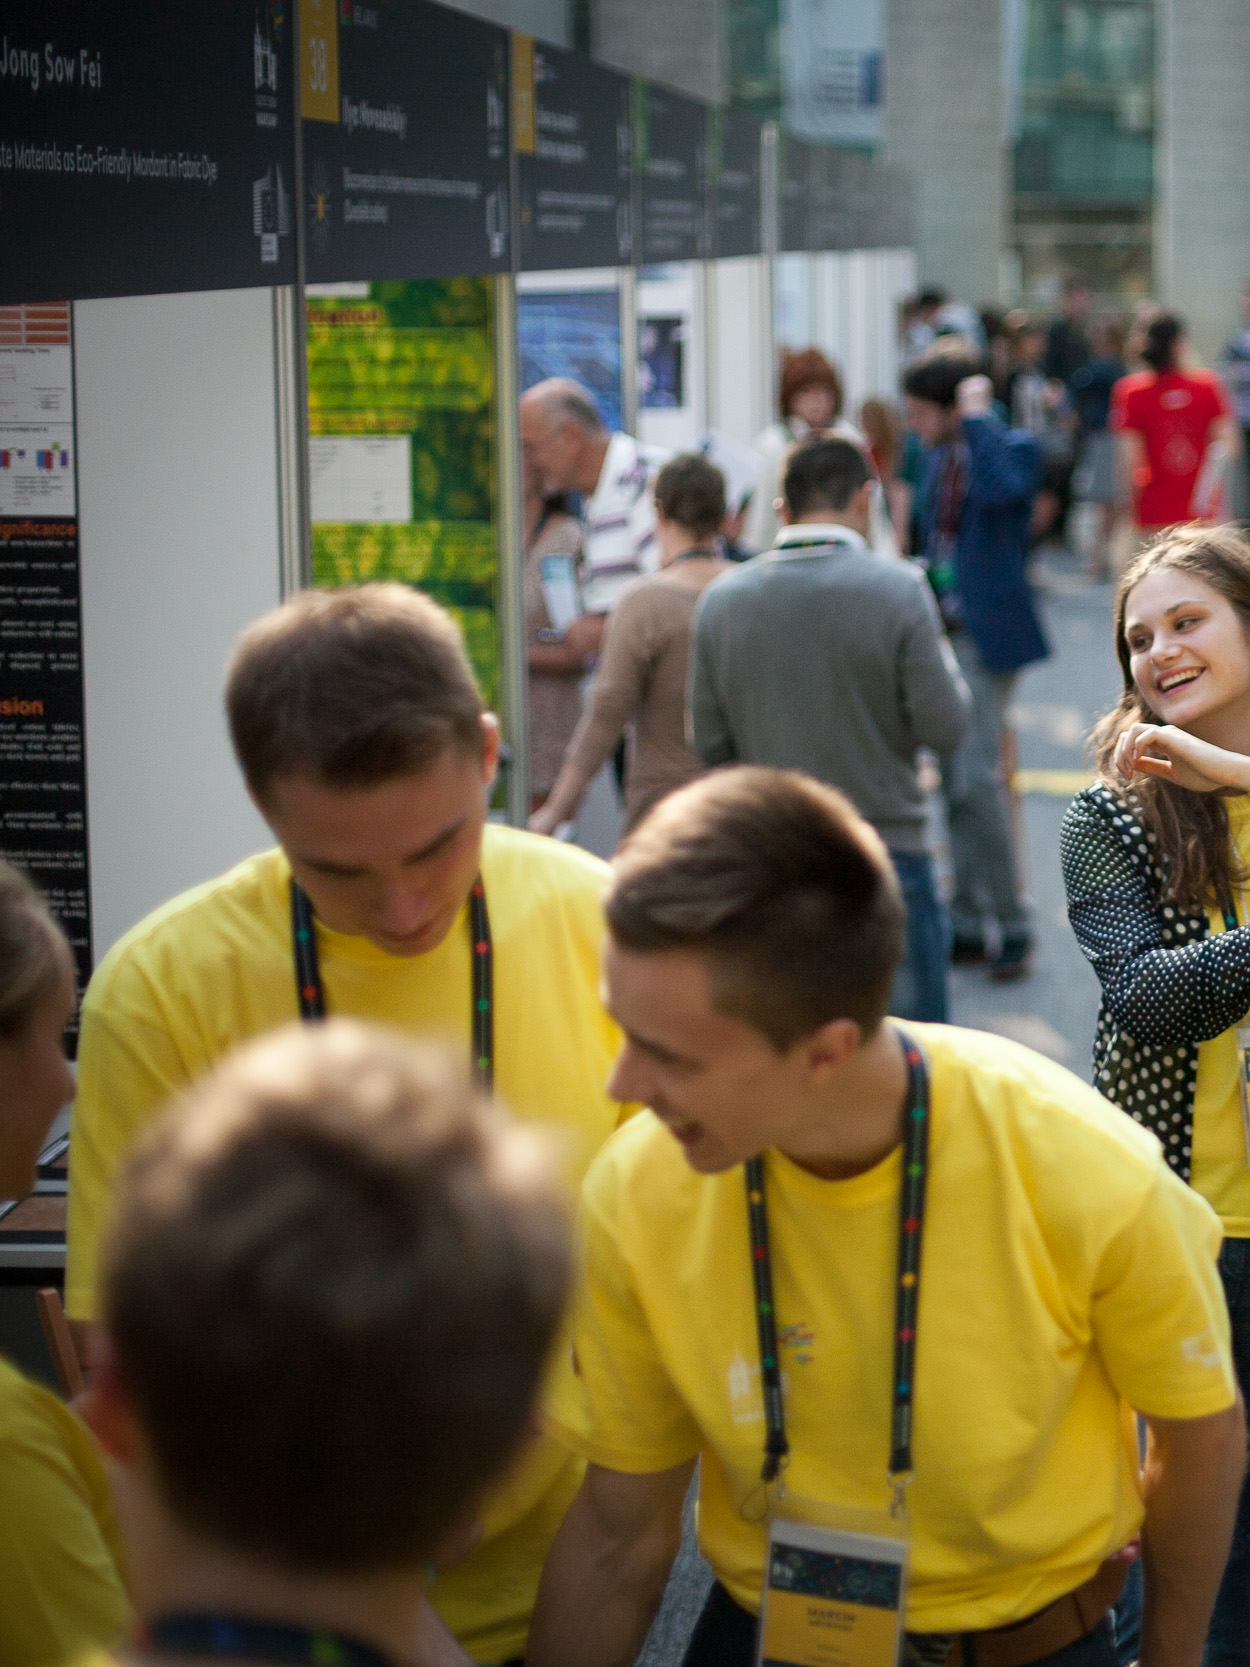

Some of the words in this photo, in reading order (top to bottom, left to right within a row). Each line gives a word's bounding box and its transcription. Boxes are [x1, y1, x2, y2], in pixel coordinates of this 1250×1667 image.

[0, 35, 39, 91] Jong
[45, 42, 75, 82] Sow
[79, 48, 102, 88] Fei
[309, 37, 328, 93] 38
[0, 141, 13, 168] te
[14, 140, 62, 170] Materials
[63, 151, 75, 172] as
[76, 144, 132, 182] Eco-Friendly
[132, 150, 168, 176] Mordant
[168, 152, 177, 177] in
[177, 152, 201, 179] Fabric
[201, 154, 218, 187] Dye
